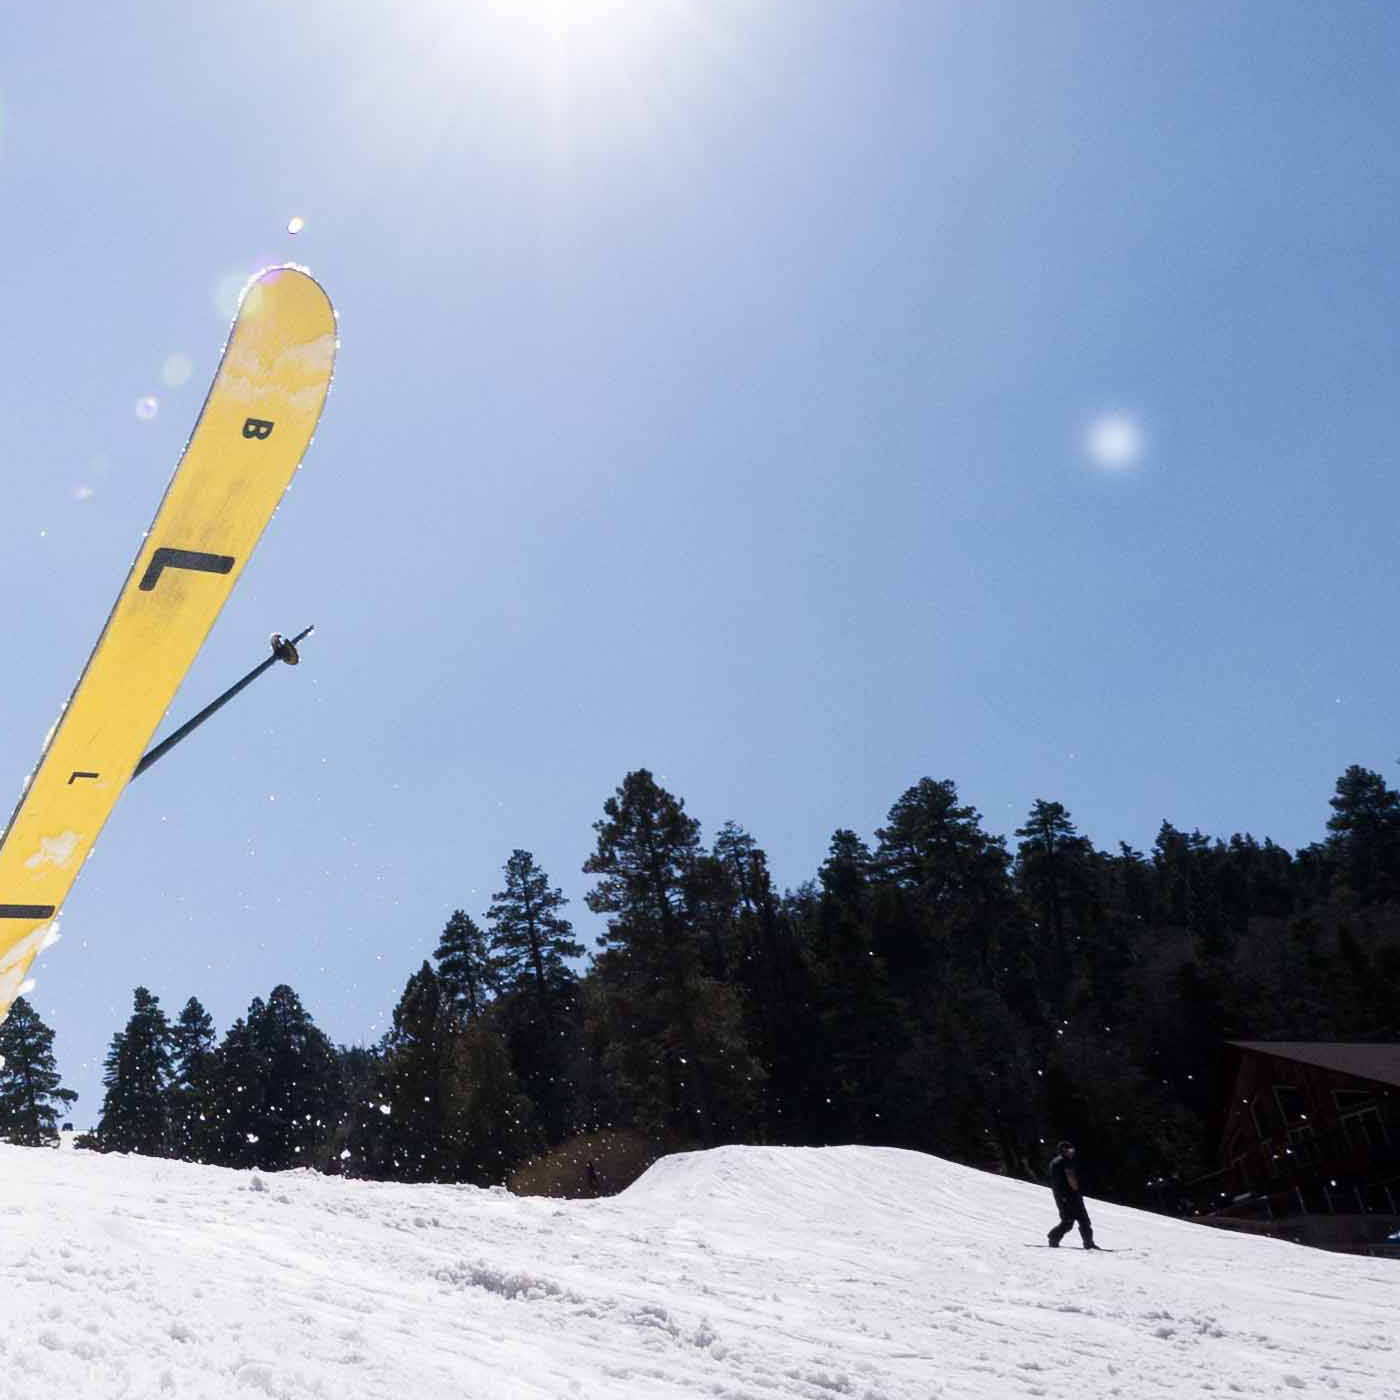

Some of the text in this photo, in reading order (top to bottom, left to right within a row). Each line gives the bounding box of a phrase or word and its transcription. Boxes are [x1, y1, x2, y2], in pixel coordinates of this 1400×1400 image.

[242, 417, 274, 440] B
[138, 547, 236, 592] L
[68, 771, 99, 785] L
